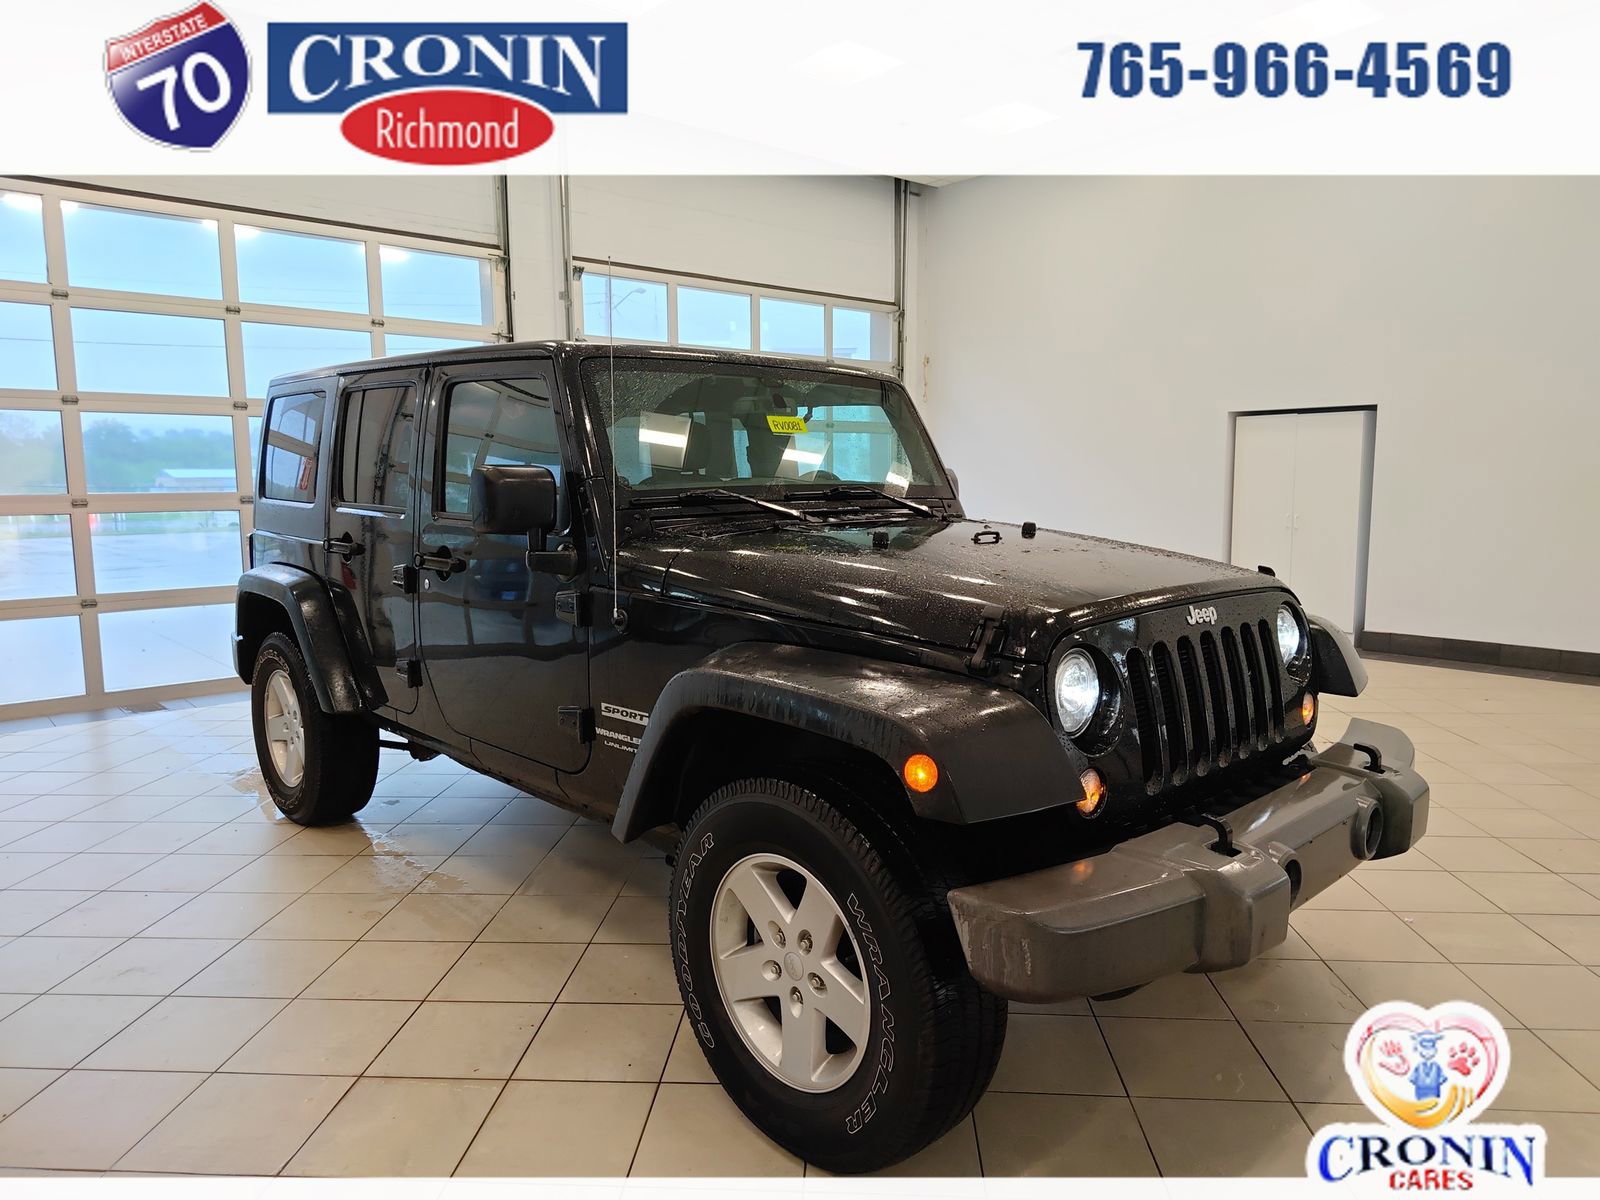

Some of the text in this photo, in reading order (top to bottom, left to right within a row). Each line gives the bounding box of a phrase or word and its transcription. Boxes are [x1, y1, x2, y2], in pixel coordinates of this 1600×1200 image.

[1186, 605, 1218, 625] Jeep
[602, 705, 649, 721] SPORT
[595, 727, 642, 745] WRANGLE
[604, 740, 638, 753] UNLIMIT
[676, 832, 714, 1049] GOODYEAR
[846, 893, 895, 1134] WRANGLER
